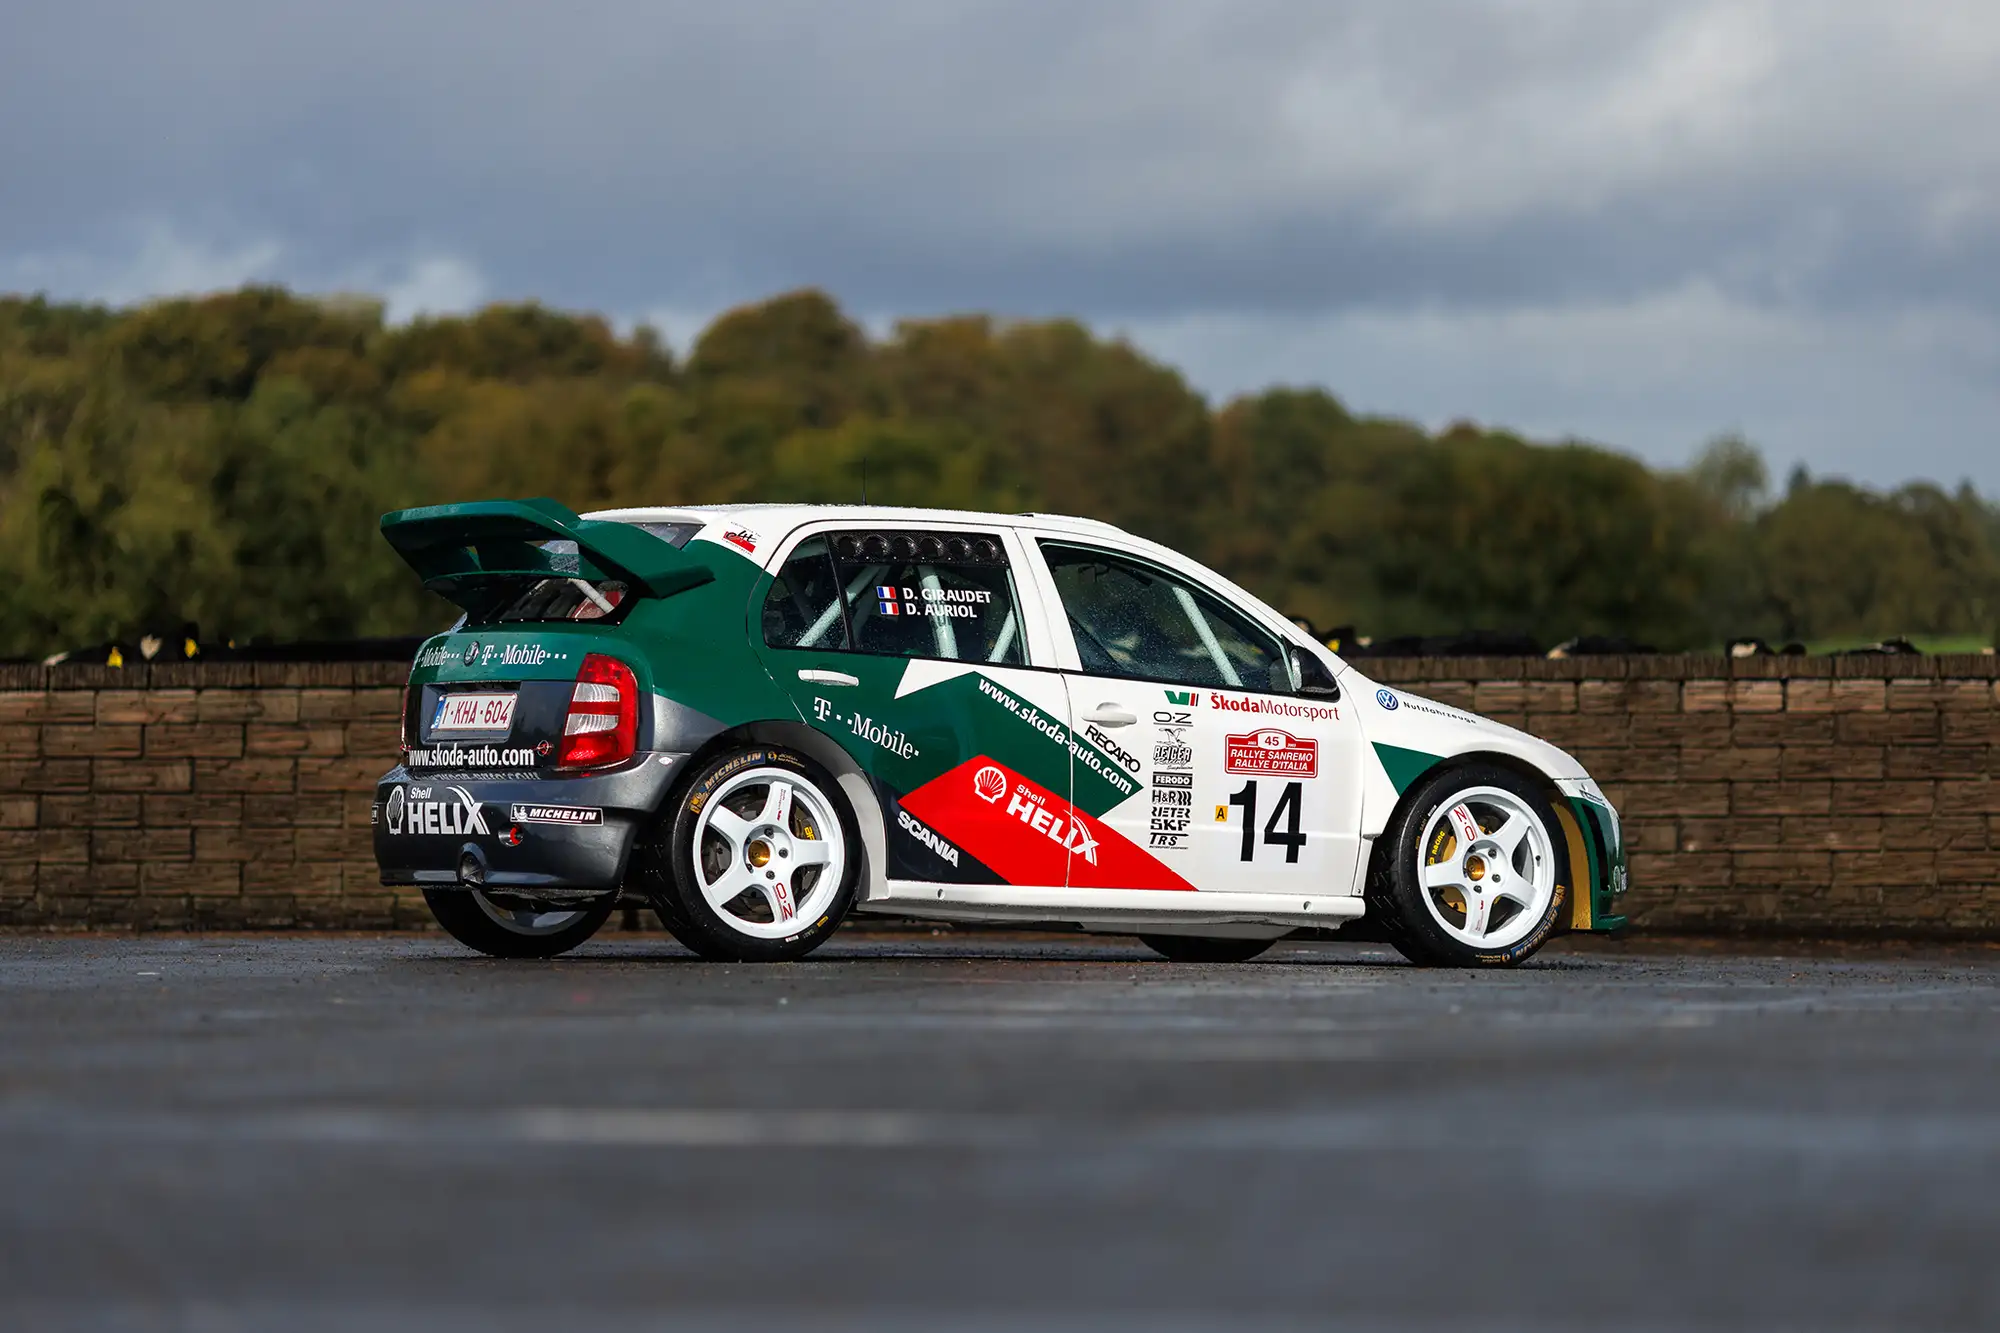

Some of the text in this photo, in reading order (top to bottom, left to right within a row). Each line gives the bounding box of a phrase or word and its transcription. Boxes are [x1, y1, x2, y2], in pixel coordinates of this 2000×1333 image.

[902, 587, 991, 604] D. GIRAUDET
[905, 602, 978, 618] D. AURIOL
[978, 679, 1133, 795] www.skoda-auto.com
[1264, 736, 1279, 746] 45
[409, 743, 535, 766] www.skoda-auto.com
[1085, 725, 1141, 773] RECARO
[1230, 748, 1313, 762] RALLYE SANREMO
[704, 752, 762, 790] MICHELIN
[1234, 758, 1308, 771] RALLYE D'ITALIA
[1155, 775, 1190, 785] FERODO
[411, 787, 433, 799] Shell
[1016, 784, 1046, 806] Shell
[1152, 789, 1176, 804] H&R
[407, 786, 490, 835] HELIX
[528, 807, 597, 822] MICHELIN
[1151, 806, 1191, 818] RIETER
[1216, 807, 1225, 819] A
[1006, 791, 1100, 867] HELIX
[1150, 818, 1191, 831] SKF
[1229, 780, 1307, 863] 14
[897, 811, 959, 868] SCANIA
[1150, 832, 1178, 846] TRS
